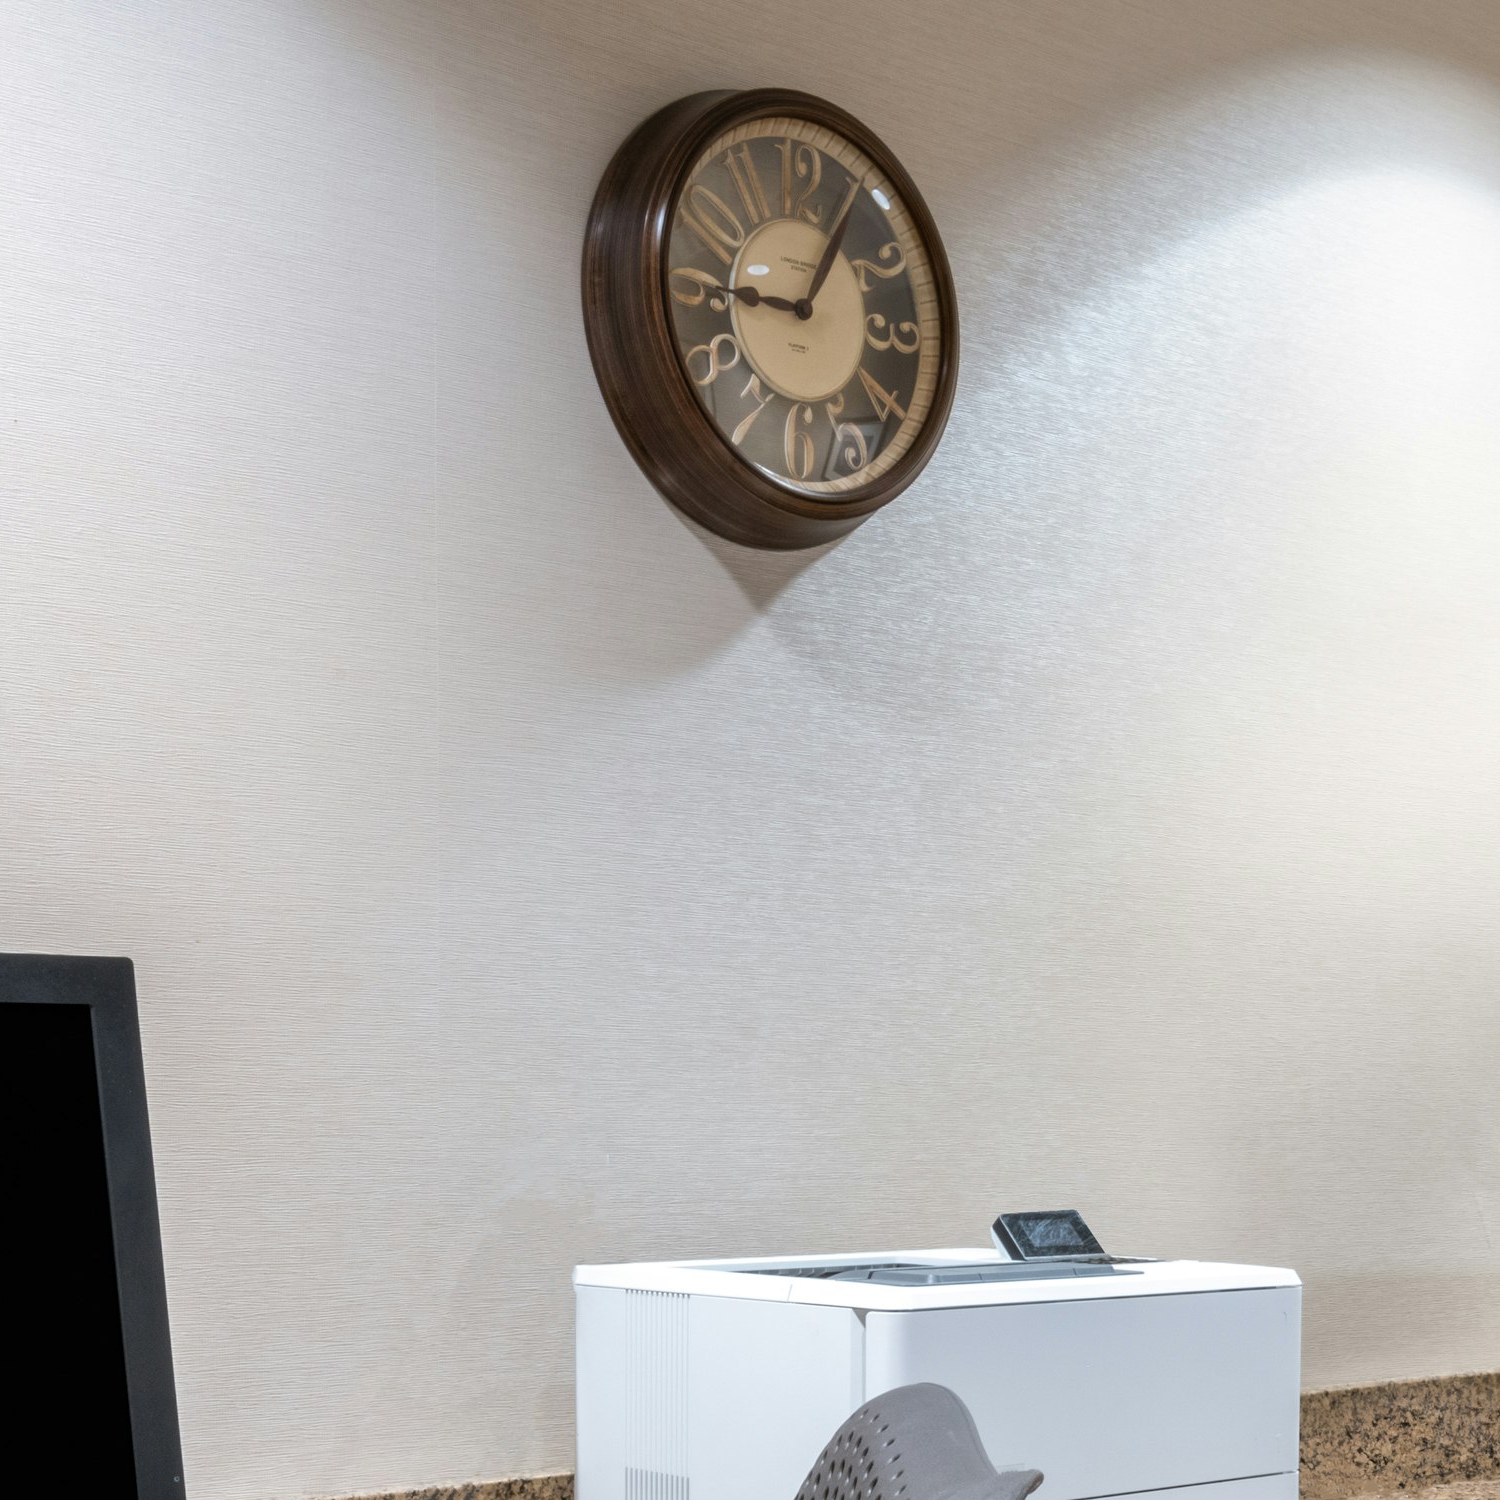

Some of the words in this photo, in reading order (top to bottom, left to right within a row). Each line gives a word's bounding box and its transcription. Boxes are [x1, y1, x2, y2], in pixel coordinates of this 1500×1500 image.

[721, 143, 771, 225] 11
[775, 138, 821, 225] 12
[680, 184, 745, 266] 10
[669, 266, 729, 313] 9
[851, 241, 905, 293] 2
[684, 333, 741, 386] 8
[865, 313, 920, 355] 3
[731, 373, 775, 446] 7
[857, 366, 906, 423] 4
[783, 403, 815, 479] 6
[825, 393, 868, 470] 5
